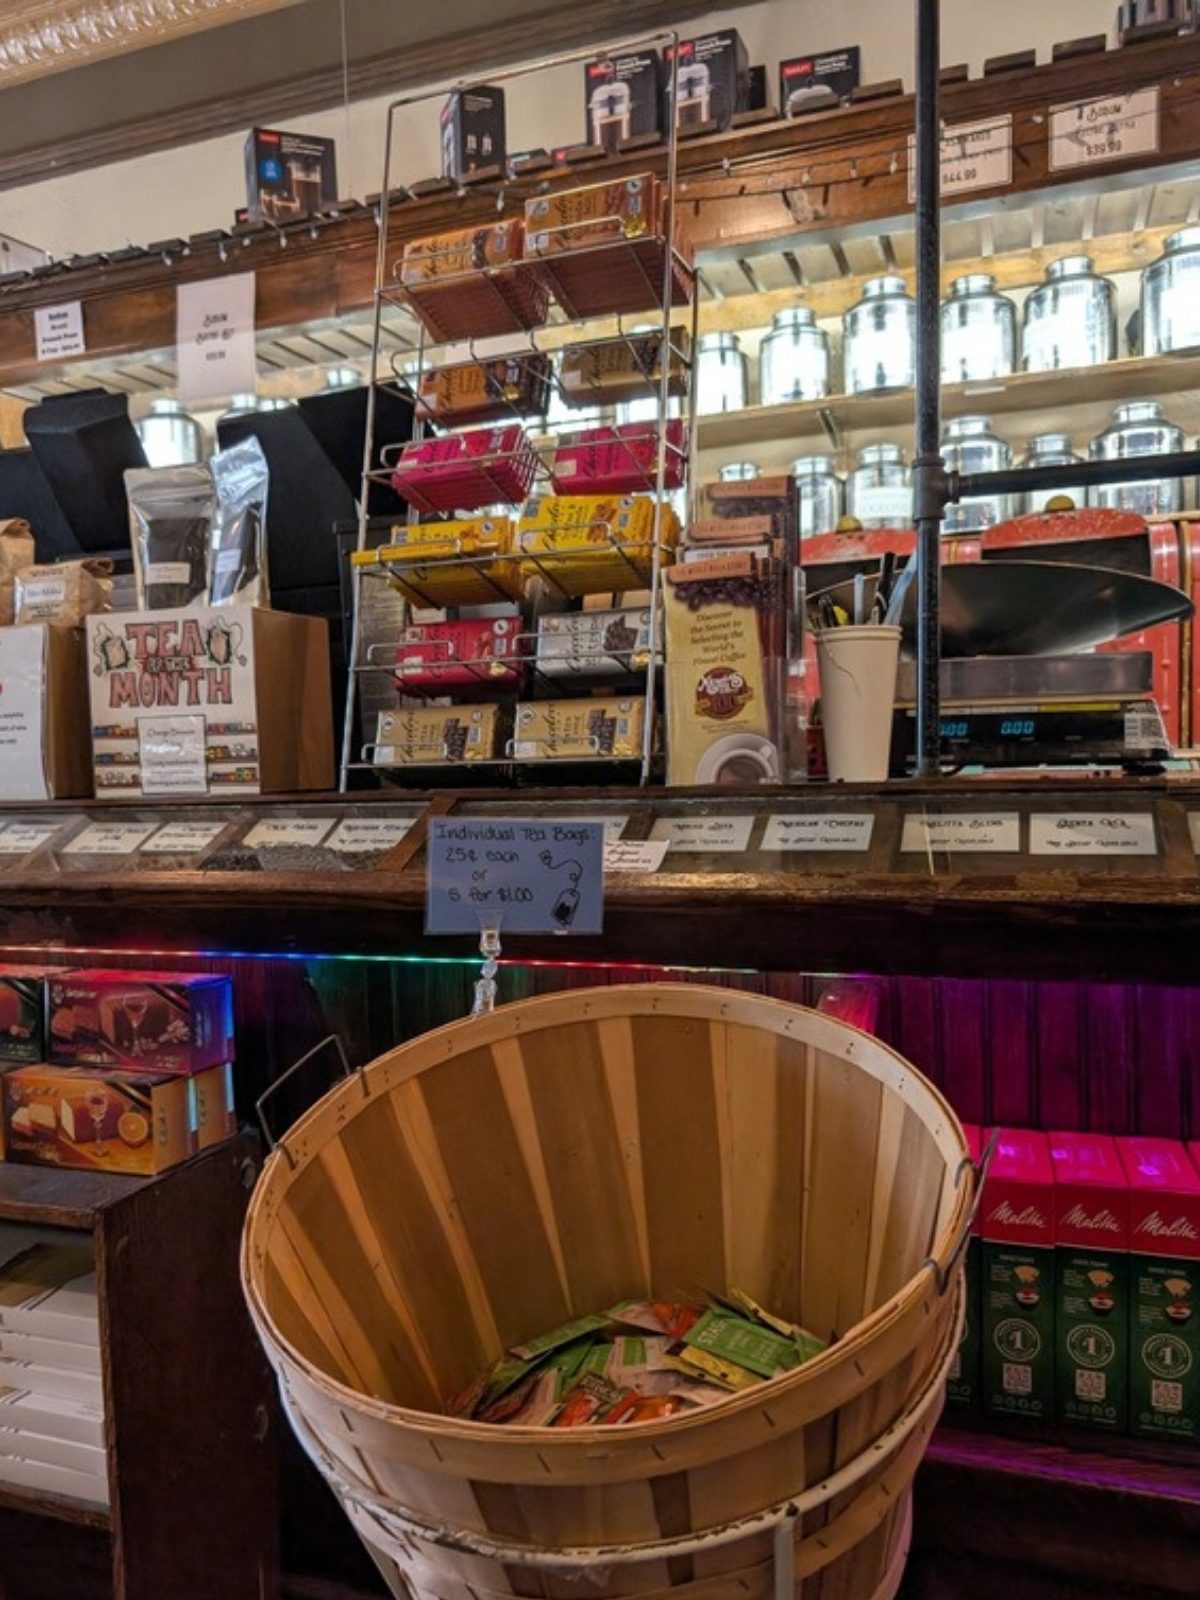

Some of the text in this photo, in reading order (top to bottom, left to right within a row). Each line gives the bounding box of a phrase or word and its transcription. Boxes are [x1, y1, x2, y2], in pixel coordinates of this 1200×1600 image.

[125, 619, 206, 660] TEA
[109, 667, 233, 708] MONTH
[435, 824, 515, 841] Individual
[520, 828, 547, 842] Tea
[485, 850, 520, 863] each
[471, 869, 488, 881] or
[468, 886, 494, 901] for
[985, 1200, 1046, 1229] Melitta
[1060, 1203, 1122, 1233] Melitta
[1134, 1210, 1199, 1240] Melitta
